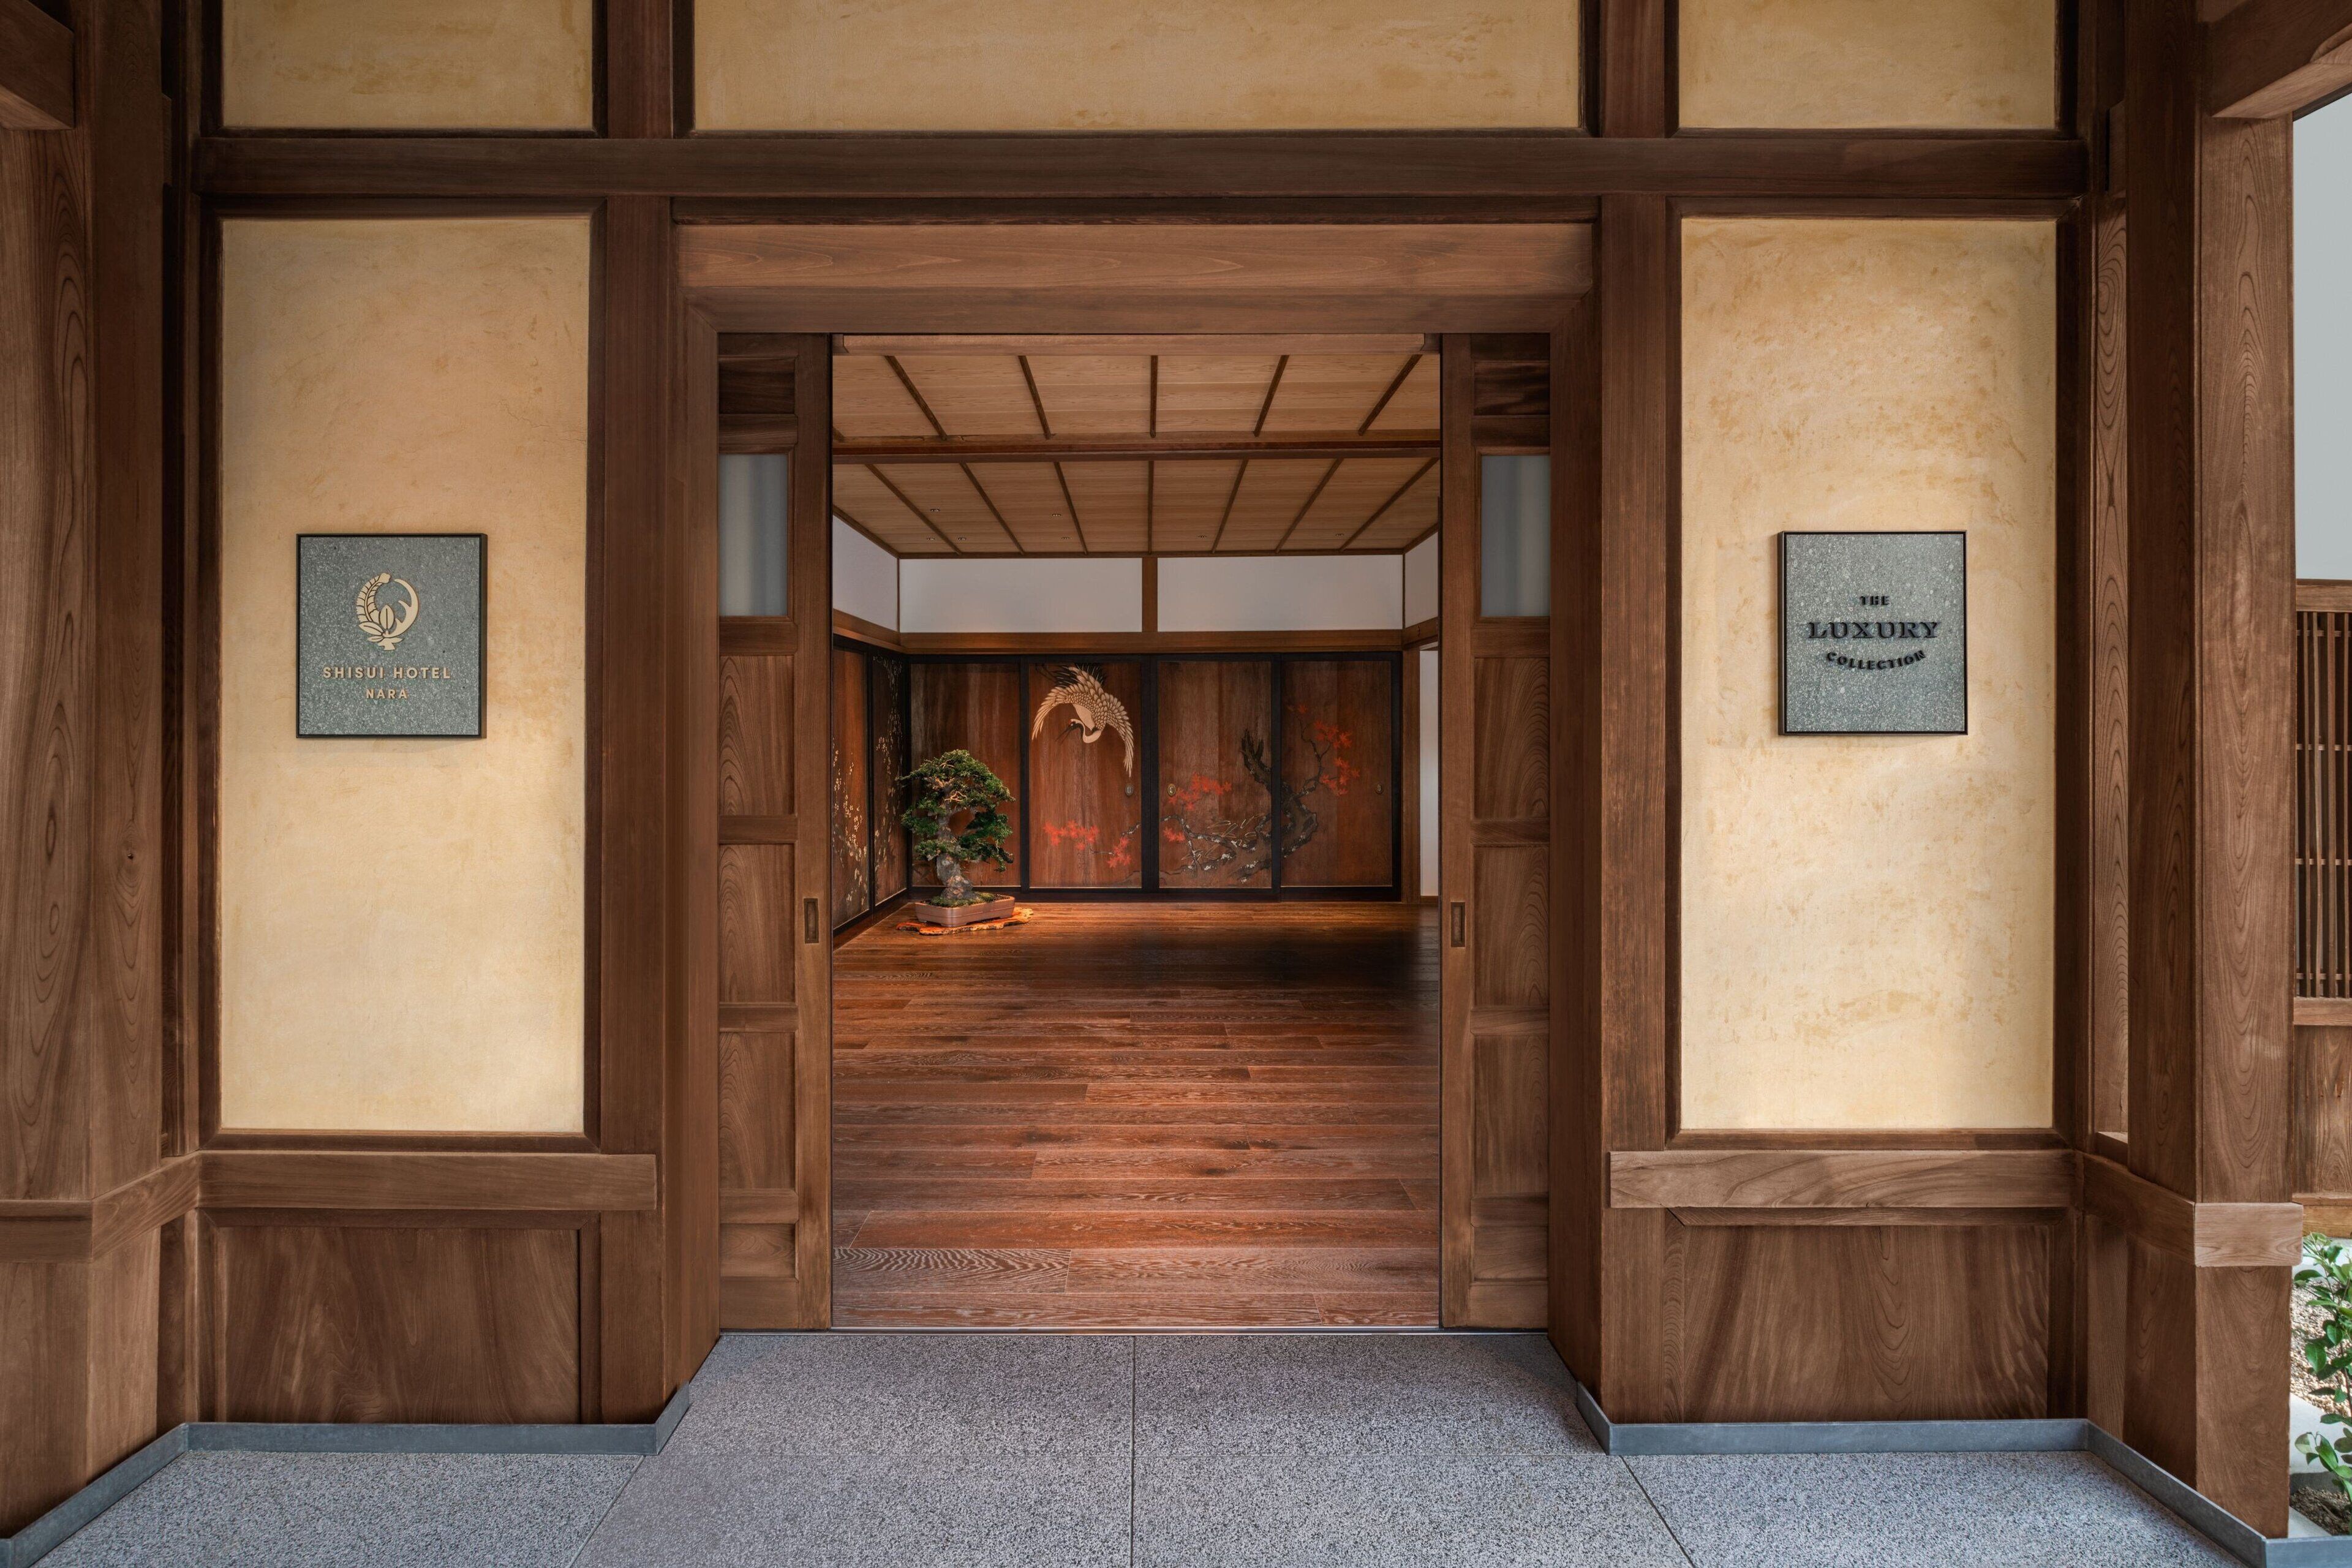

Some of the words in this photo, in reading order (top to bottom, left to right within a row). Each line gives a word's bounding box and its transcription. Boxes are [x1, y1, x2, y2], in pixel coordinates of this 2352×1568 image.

[1860, 595, 1890, 606] THE
[1808, 622, 1941, 638] LUXURY
[1826, 650, 1926, 670] COLLECTION
[323, 667, 384, 679] SHISUI
[393, 667, 451, 679] HOTEL
[366, 688, 408, 699] NARA
